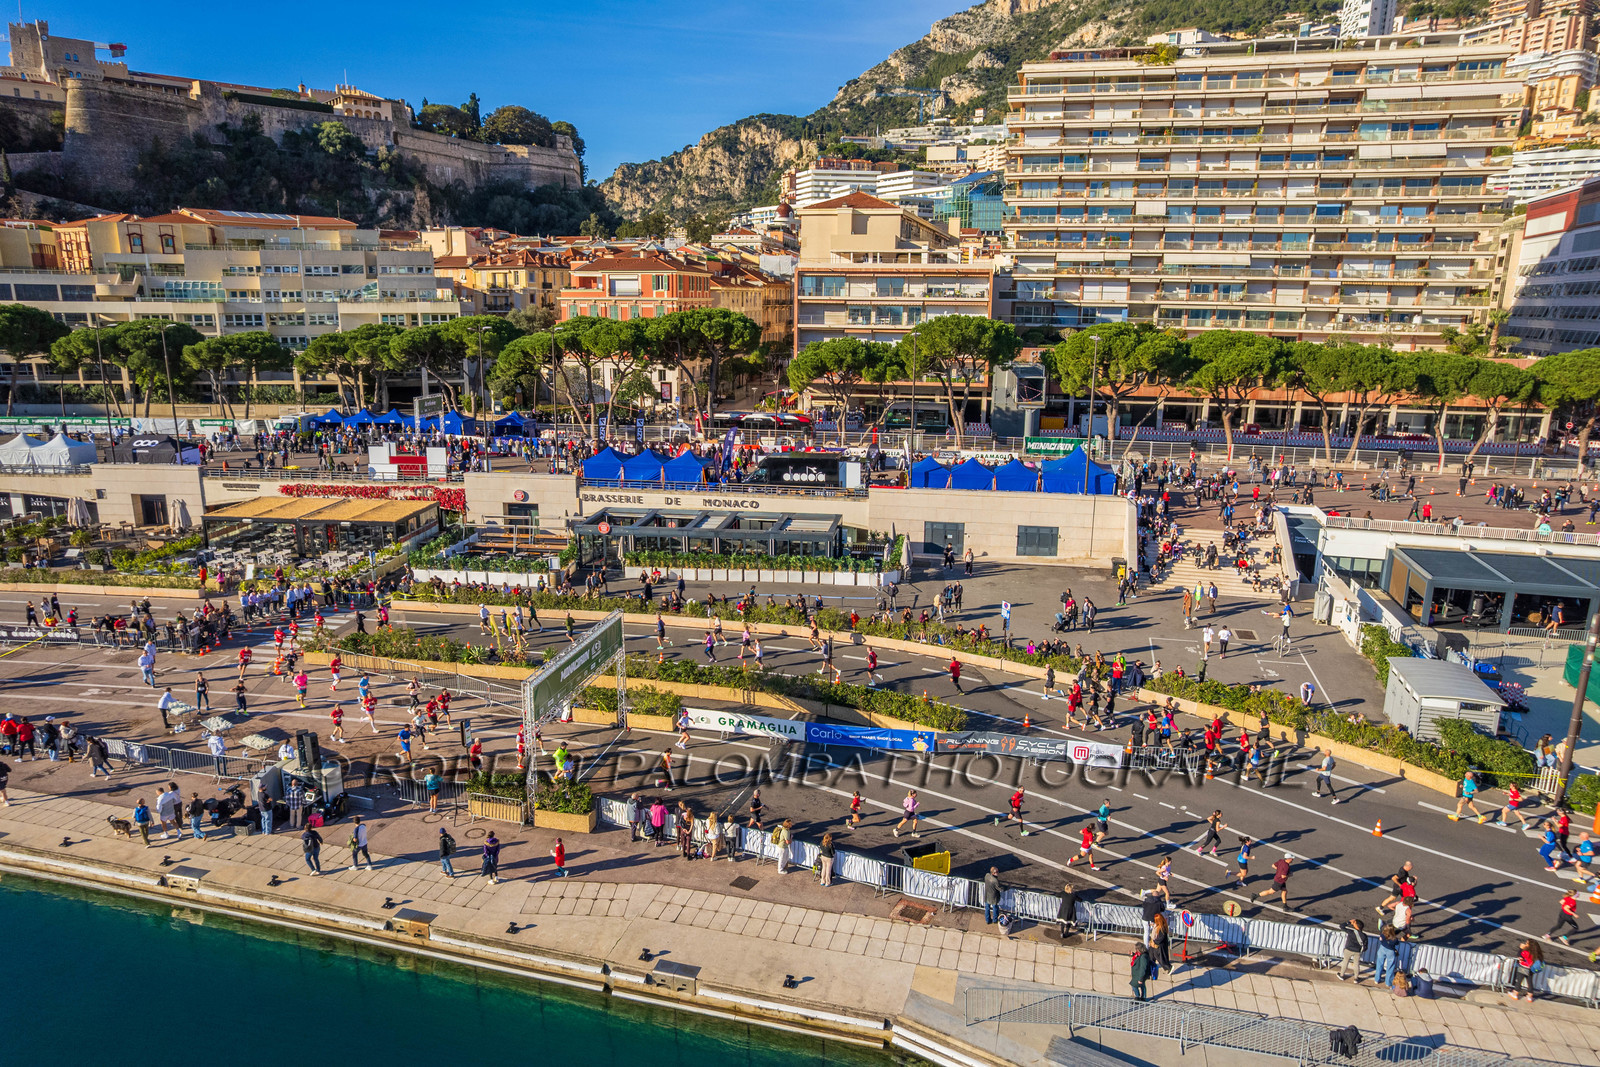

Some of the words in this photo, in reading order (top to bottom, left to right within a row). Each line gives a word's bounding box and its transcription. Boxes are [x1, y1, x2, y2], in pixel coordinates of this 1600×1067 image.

[783, 466, 825, 481] diadora
[582, 493, 644, 504] BRASSERIE
[665, 497, 681, 506] DE
[702, 499, 760, 509] MONACO
[718, 717, 798, 735] GRAMAGLIA
[810, 727, 842, 740] Carlo
[1016, 746, 1064, 755] PASSION
[1018, 740, 1066, 750] CYCLE
